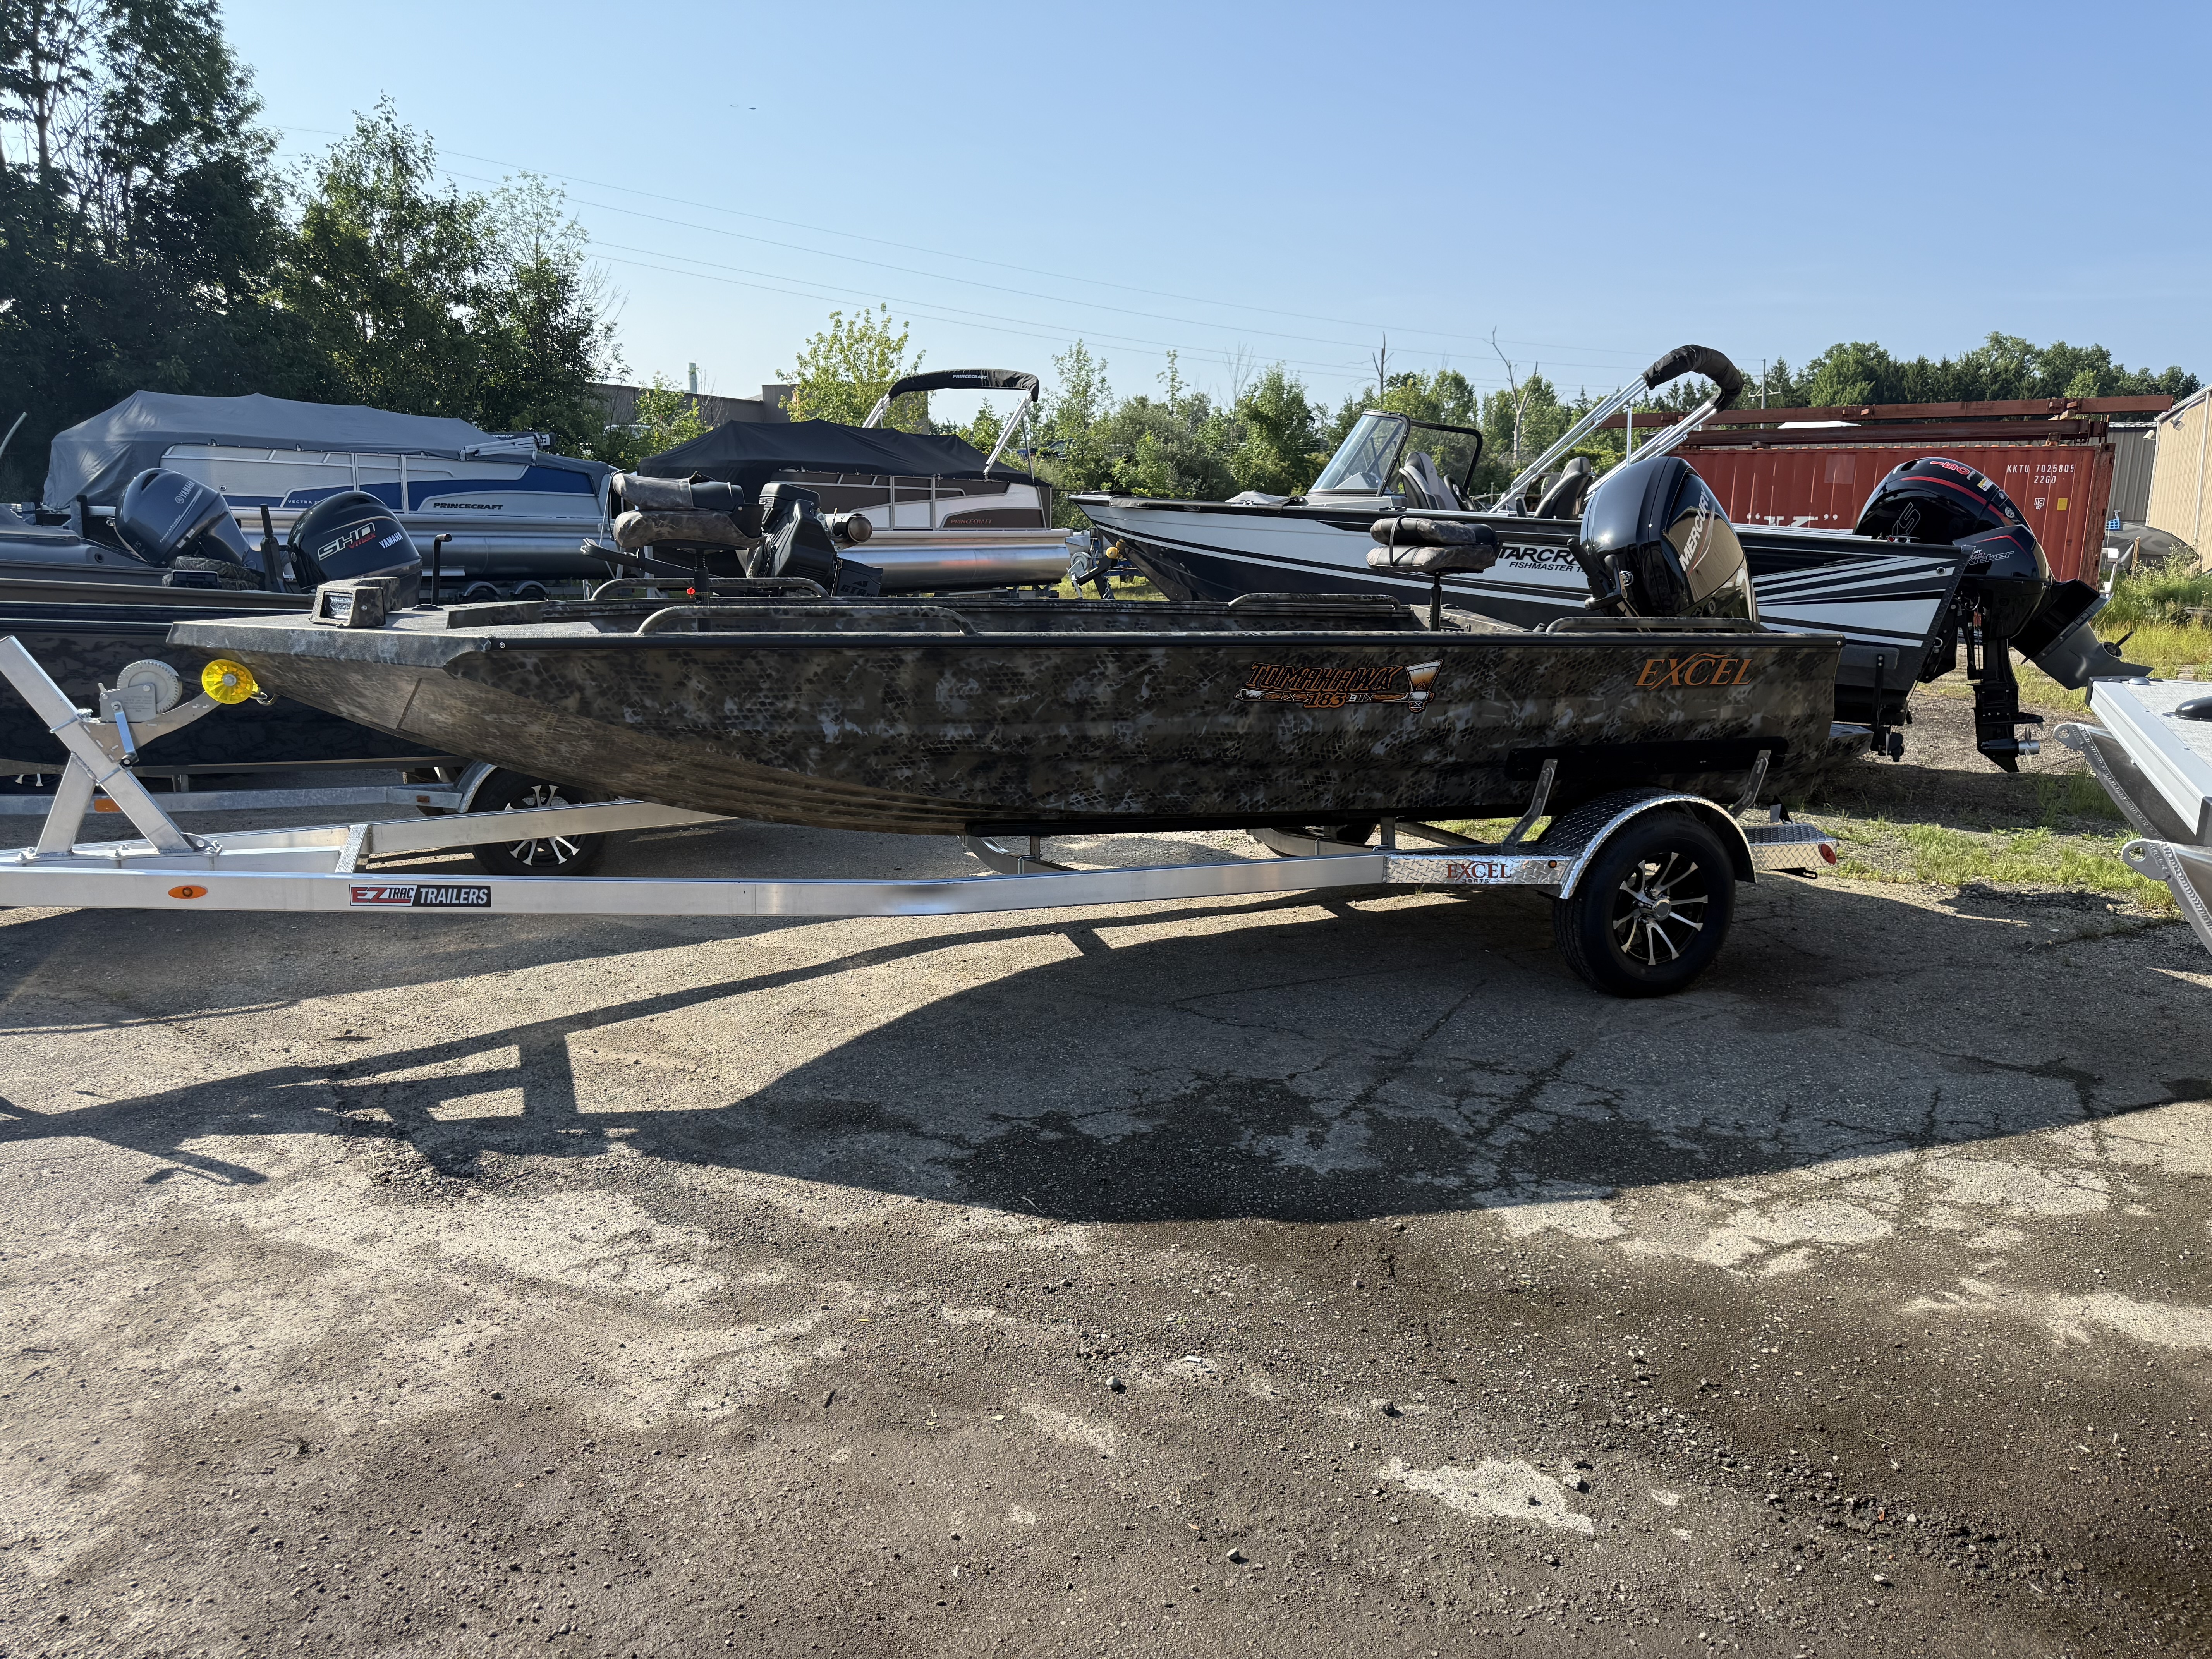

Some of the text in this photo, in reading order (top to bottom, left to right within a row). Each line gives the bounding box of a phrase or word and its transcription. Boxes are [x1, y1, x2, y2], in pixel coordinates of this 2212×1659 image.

[2007, 465, 2029, 473] KKTU
[178, 480, 195, 498] YAMAHA
[1679, 485, 1709, 571] MERCURY
[379, 532, 403, 549] YAMAHA
[1509, 562, 1573, 572] FISHMASTER
[1245, 662, 1403, 691] TOMAHAWK
[1635, 653, 1753, 691] EXCEL
[1304, 692, 1346, 708] 183
[1447, 861, 1511, 880] EXCEL
[388, 887, 414, 898] TRAC
[420, 888, 488, 904] TRAILERS
